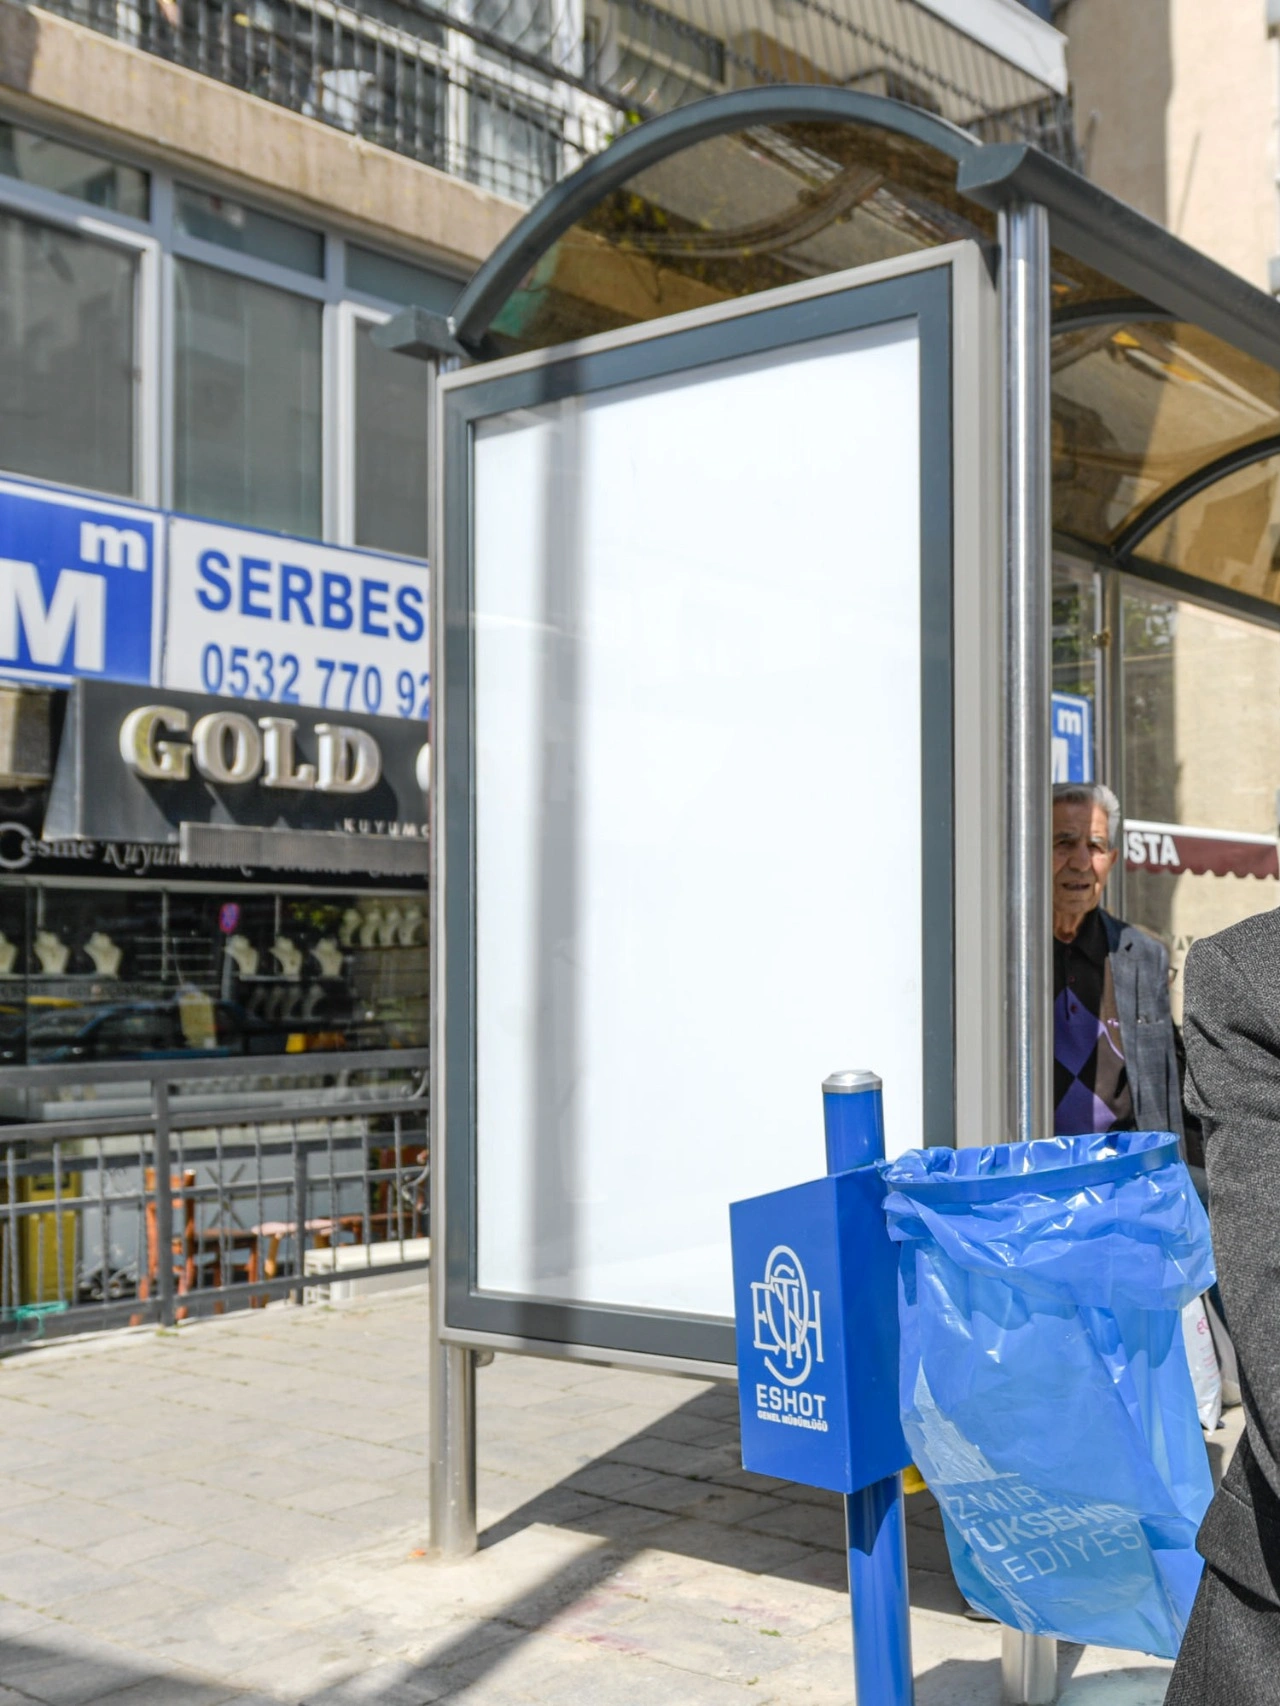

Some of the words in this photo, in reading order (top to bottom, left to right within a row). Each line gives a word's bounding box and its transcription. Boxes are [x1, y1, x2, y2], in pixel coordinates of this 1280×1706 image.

[195, 550, 425, 642] SERBES
[201, 643, 300, 705] 0532
[315, 658, 381, 715] 770
[119, 705, 382, 793] GOLD
[1123, 830, 1180, 866] STA
[756, 1383, 826, 1419] ESHOT
